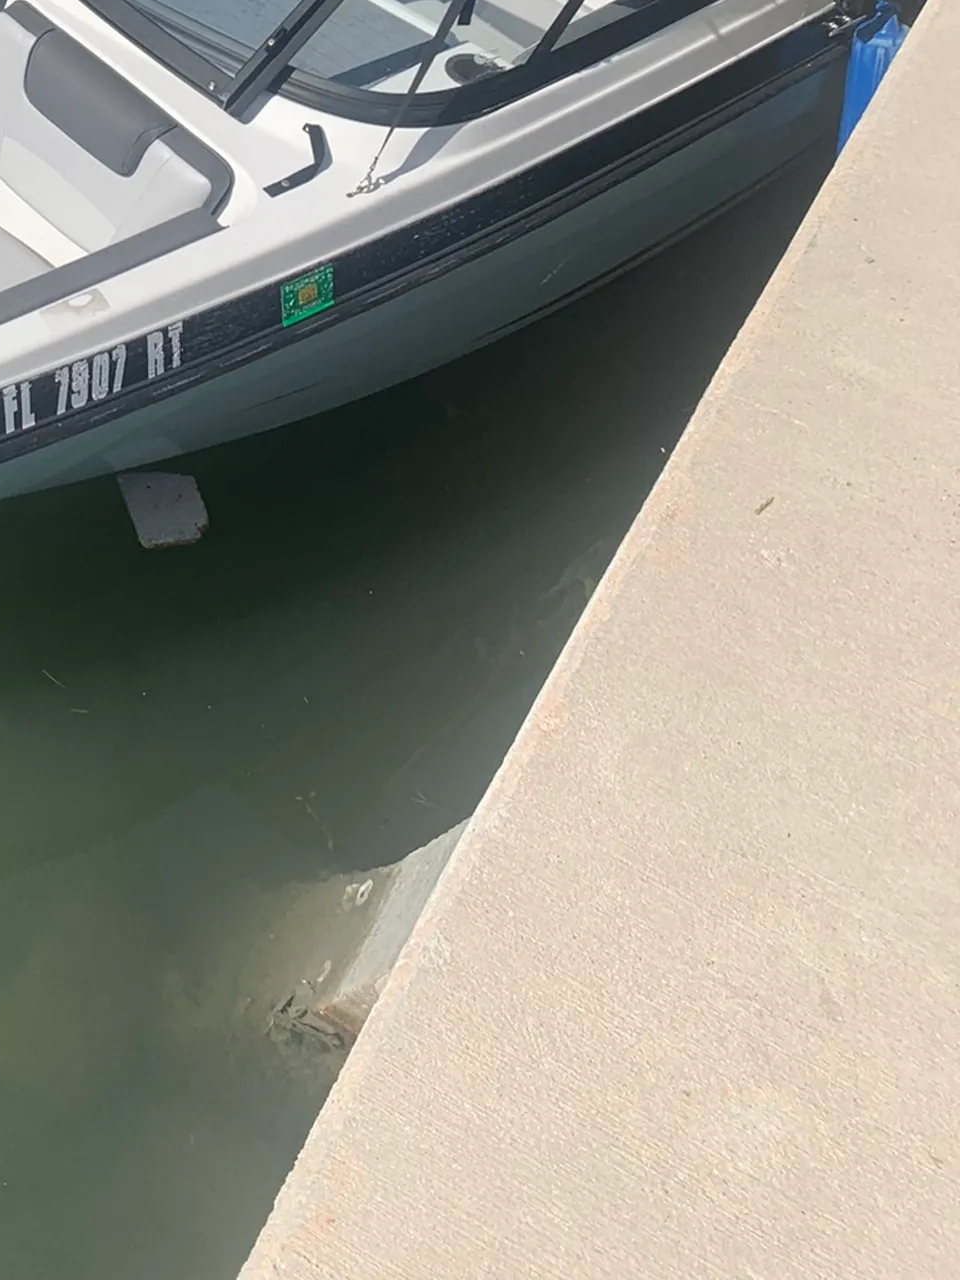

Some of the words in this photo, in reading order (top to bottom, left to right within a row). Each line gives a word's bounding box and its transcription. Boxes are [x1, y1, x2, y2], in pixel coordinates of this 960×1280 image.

[3, 382, 35, 434] FL
[55, 344, 126, 415] 7907
[147, 321, 182, 379] RT
